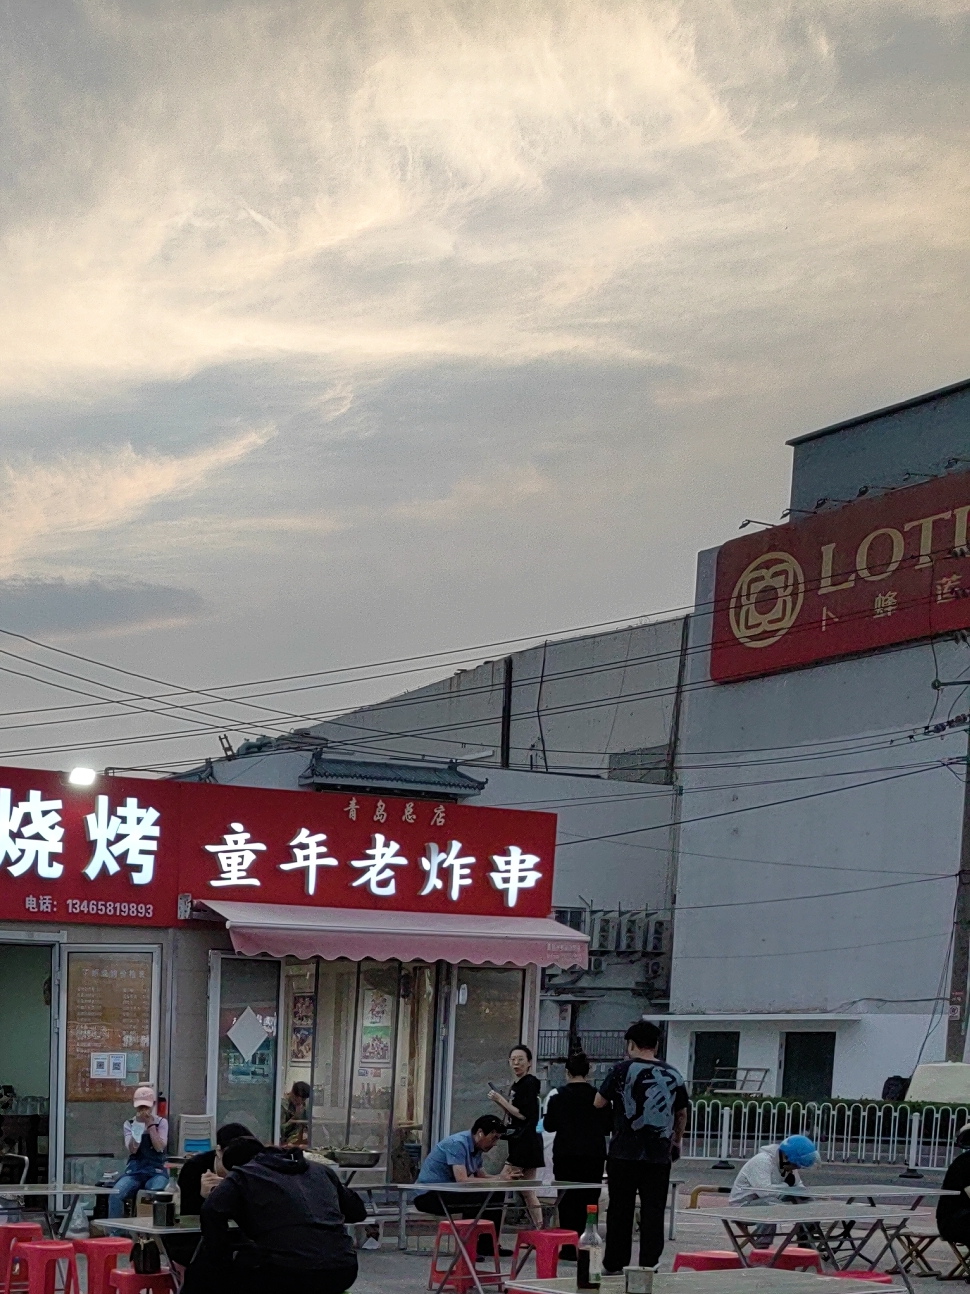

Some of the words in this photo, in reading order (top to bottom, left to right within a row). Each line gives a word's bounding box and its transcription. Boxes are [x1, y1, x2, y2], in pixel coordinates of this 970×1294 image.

[343, 797, 447, 827] 青岛总店
[203, 822, 543, 908] 童年老炸串
[66, 899, 153, 917] 13465819893
